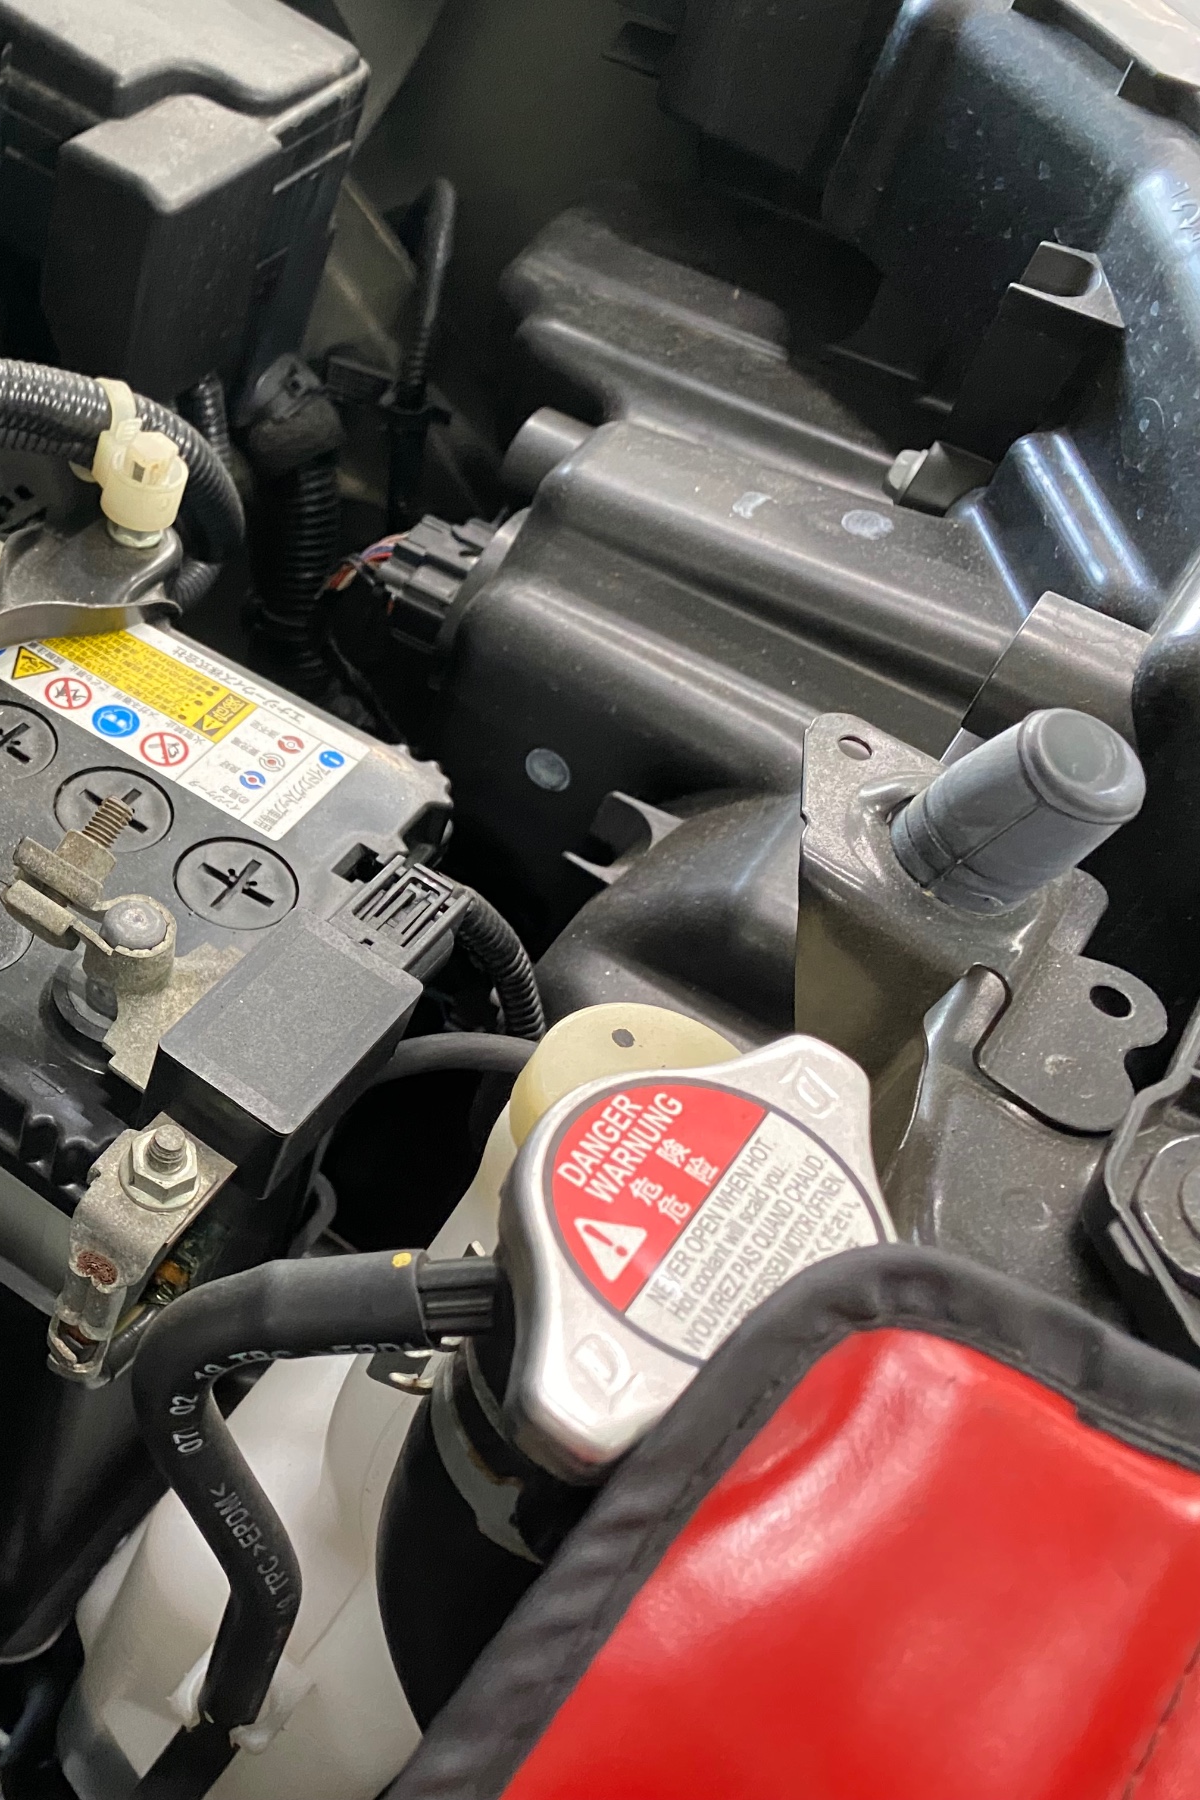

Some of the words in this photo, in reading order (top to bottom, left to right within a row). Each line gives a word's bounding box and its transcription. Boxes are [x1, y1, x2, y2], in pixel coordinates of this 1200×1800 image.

[187, 777, 241, 814] インジケータ
[557, 1091, 643, 1189] DANGER
[584, 1089, 685, 1204] WARNUNG
[647, 1248, 695, 1306] NEVER
[683, 1206, 724, 1254] OPEN
[712, 1164, 754, 1211] WHEN
[742, 1136, 777, 1171] HOT.
[668, 1291, 697, 1321] Hot
[686, 1241, 731, 1295] coolant
[721, 1218, 746, 1246] will
[737, 1186, 769, 1224] scald
[684, 1271, 744, 1352] N'OUVREZ
[731, 1244, 762, 1279] PAS
[751, 1197, 794, 1249] QUAND
[782, 1153, 827, 1204] CHAUD.
[777, 1211, 817, 1258] MOTOR
[169, 1394, 199, 1416] 02
